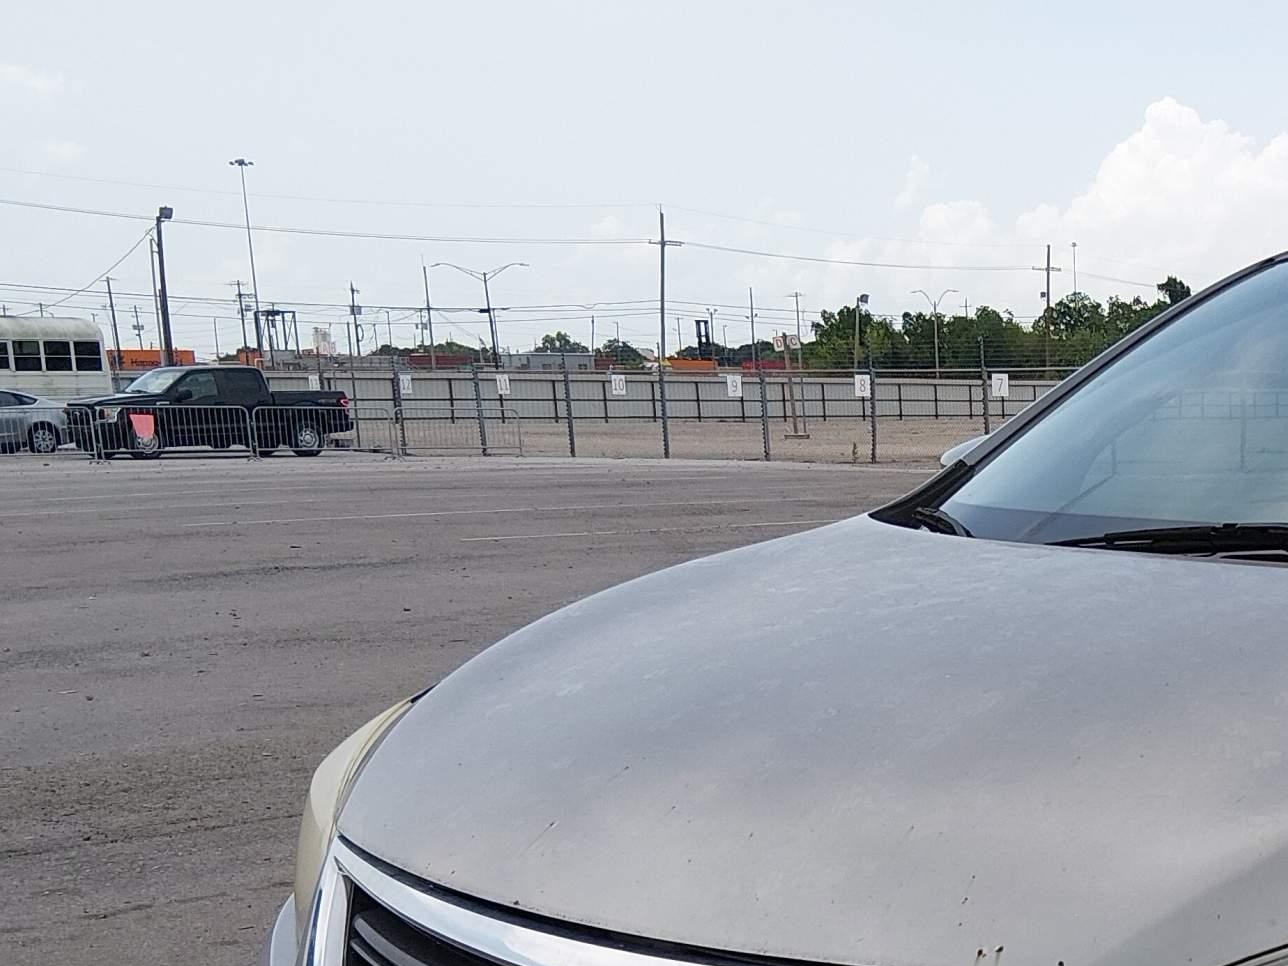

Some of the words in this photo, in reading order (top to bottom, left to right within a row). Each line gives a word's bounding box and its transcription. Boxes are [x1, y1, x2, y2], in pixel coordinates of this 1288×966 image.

[613, 379, 625, 392] 10
[731, 379, 738, 393] 9
[859, 379, 866, 392] 8
[995, 378, 1003, 392] 7
